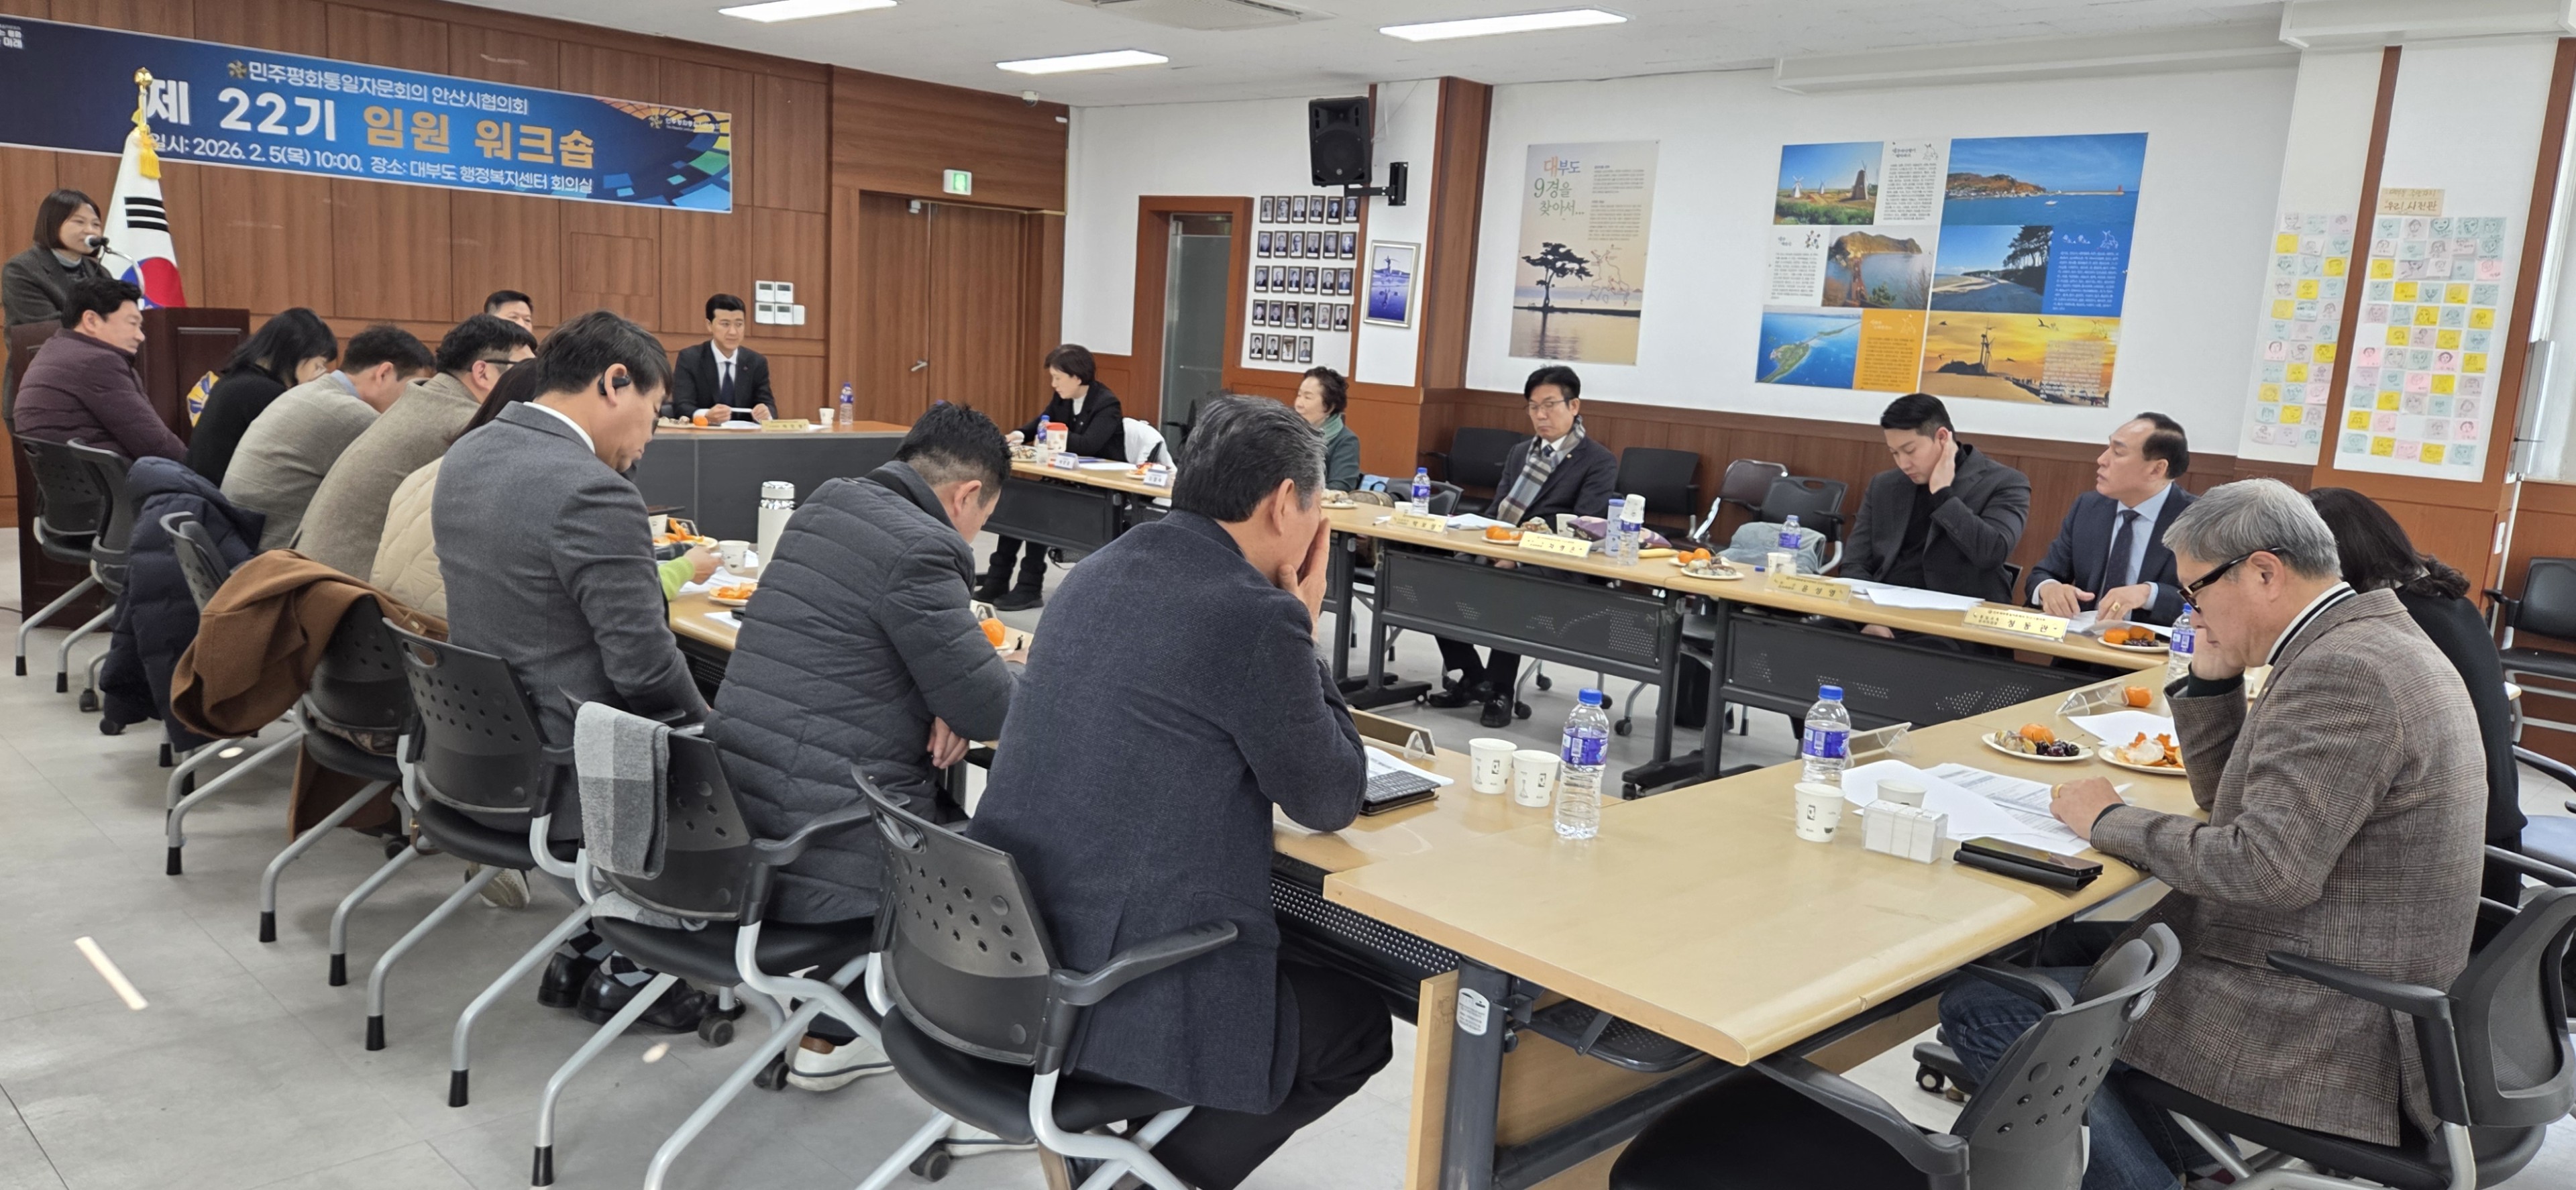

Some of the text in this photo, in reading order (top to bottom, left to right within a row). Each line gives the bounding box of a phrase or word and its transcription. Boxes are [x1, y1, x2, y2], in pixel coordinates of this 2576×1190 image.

[248, 61, 529, 115] 민주평화통일자문회의 안산시협의회
[147, 79, 594, 169] 제 22기 임원 워크숍
[151, 133, 189, 154] 일시:
[193, 138, 246, 159] 2026.
[249, 144, 266, 162] 2.
[269, 146, 311, 166] 5(목)
[370, 156, 408, 174] 장소:
[410, 160, 457, 180] 대부도
[460, 165, 547, 189] 행정복지센터
[550, 174, 593, 194] 회의실
[1544, 156, 1580, 176] 대부도
